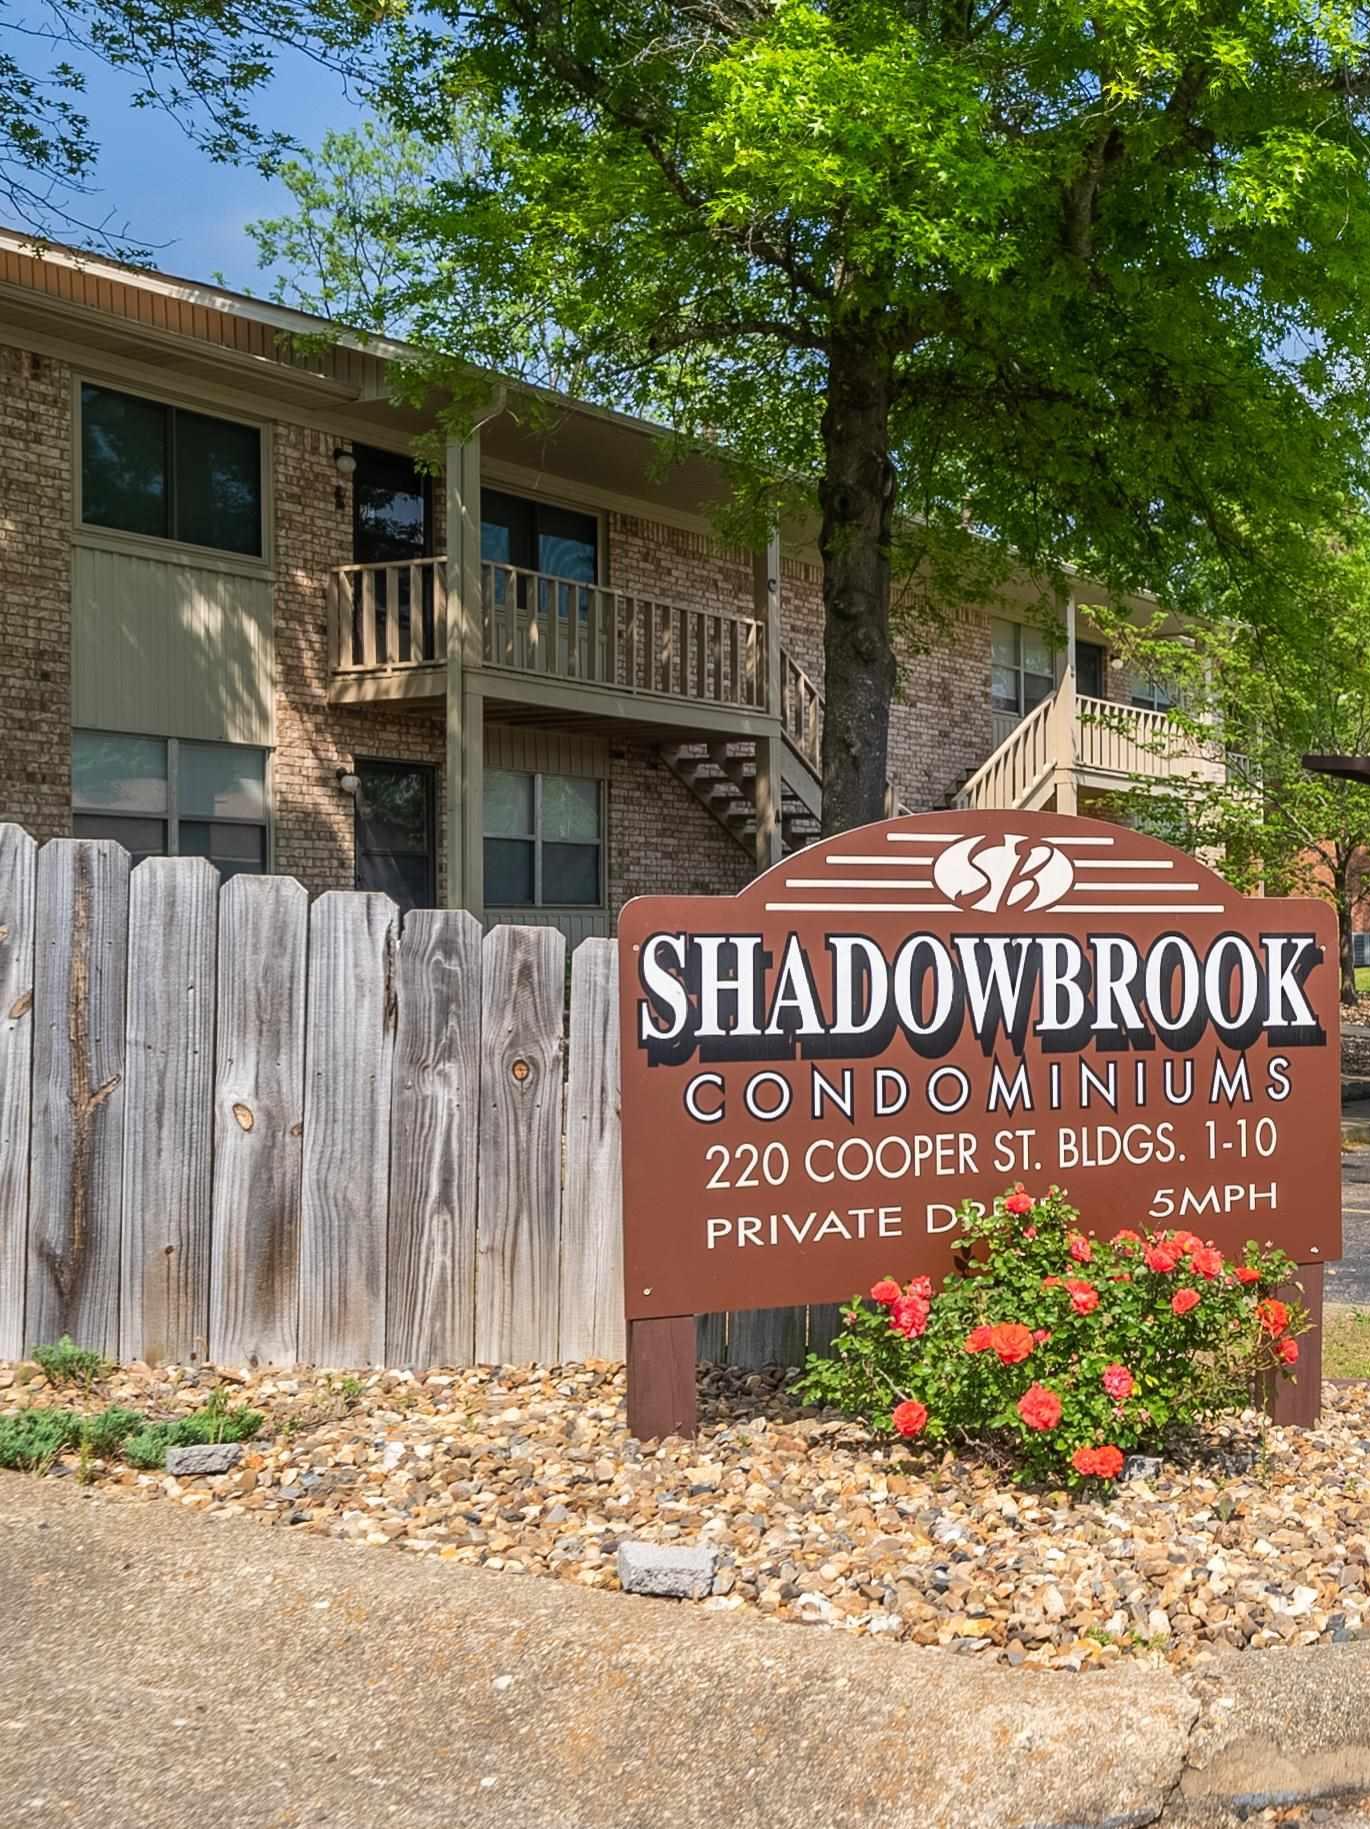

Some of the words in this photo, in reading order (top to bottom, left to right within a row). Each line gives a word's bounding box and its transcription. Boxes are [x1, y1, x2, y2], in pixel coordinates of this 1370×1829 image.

[639, 932, 1322, 1045] SHADOWBROOK
[684, 1056, 1292, 1122] CONDOMINIUMS
[705, 1142, 789, 1189] 220
[804, 1132, 979, 1183] COOPER
[993, 1129, 1042, 1172] ST.
[1059, 1122, 1187, 1169] BLDGS.
[1205, 1117, 1277, 1159] 1-10
[706, 1206, 902, 1249] PRIVATE
[1148, 1182, 1277, 1218] 5MPH
